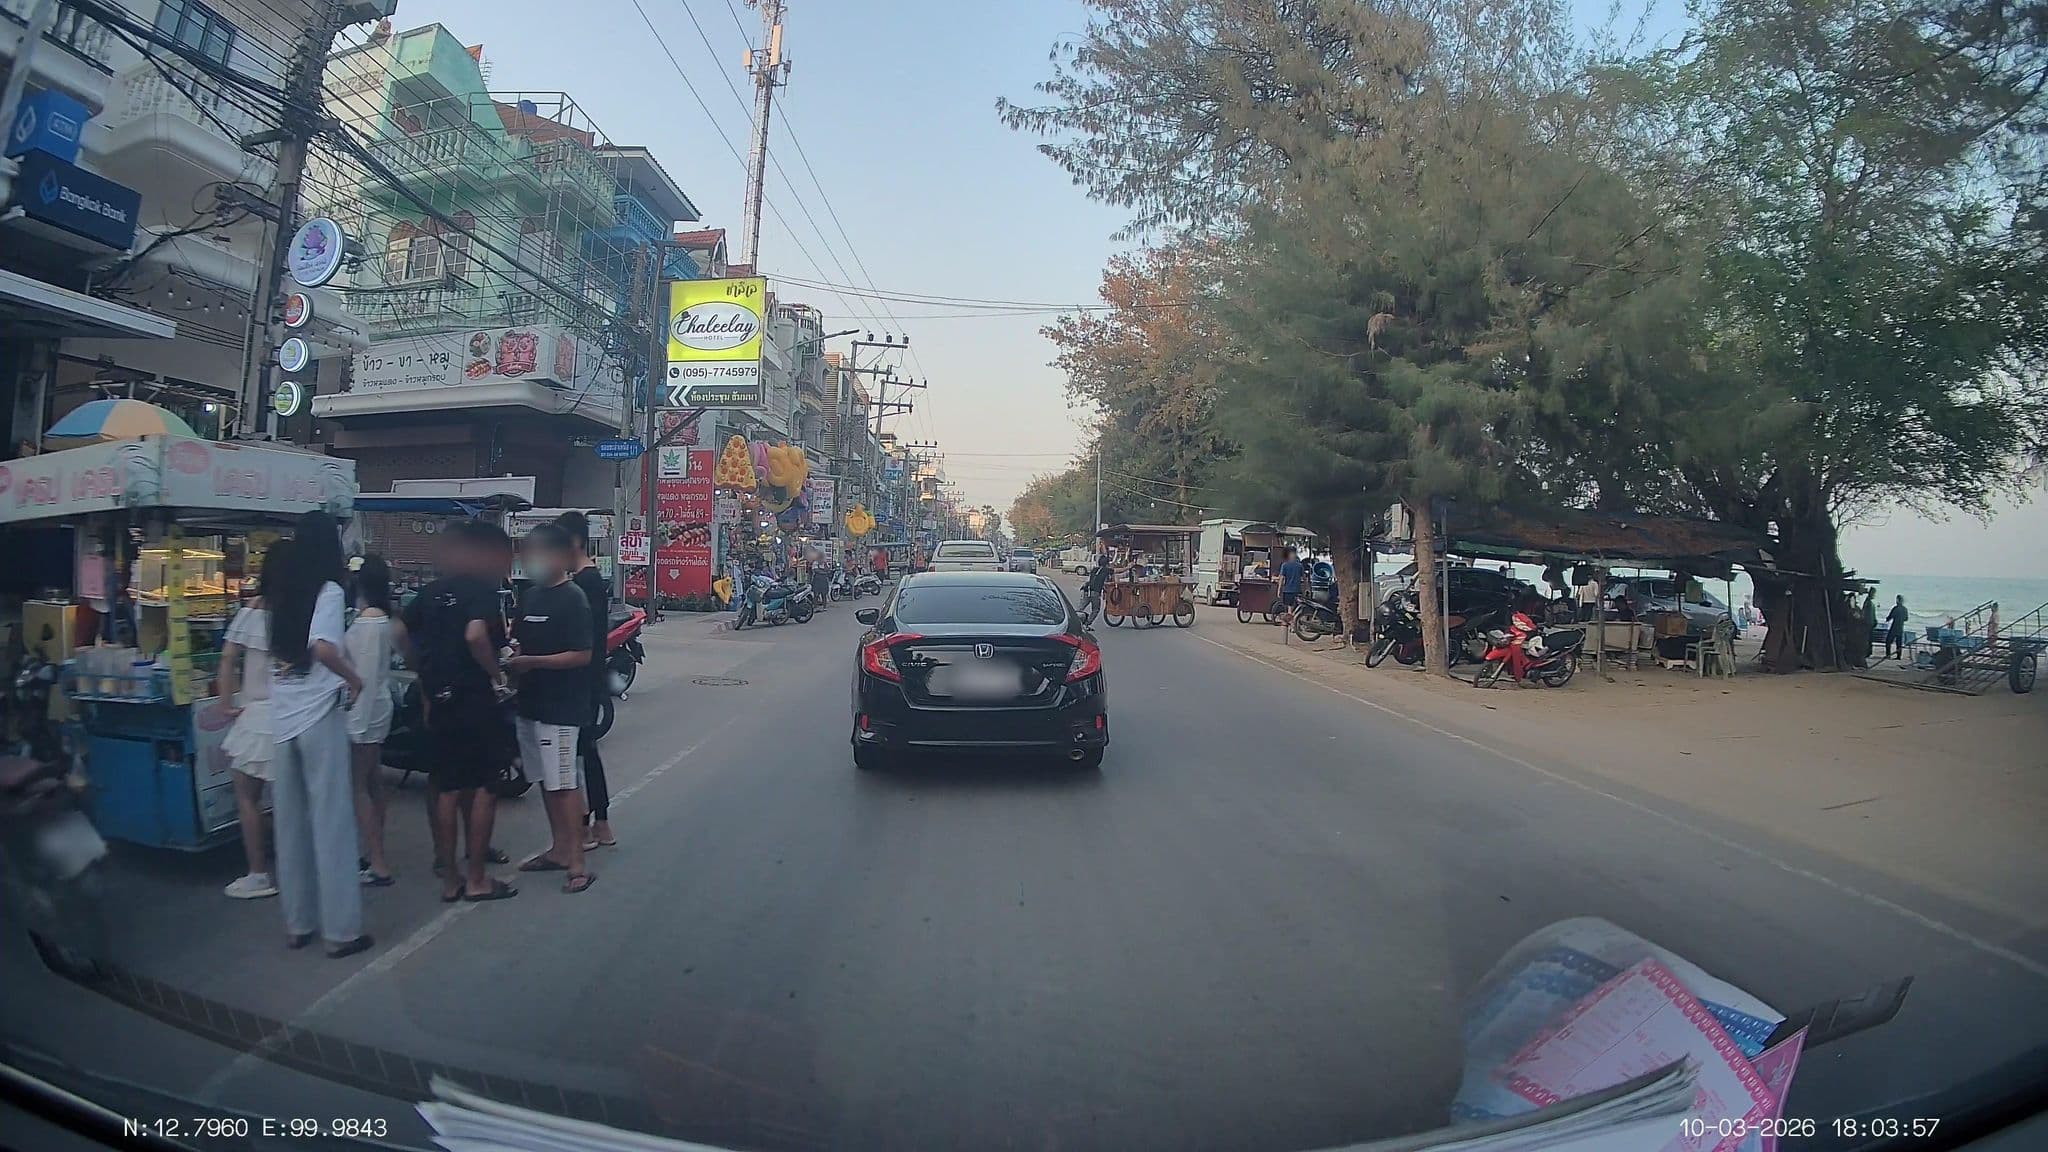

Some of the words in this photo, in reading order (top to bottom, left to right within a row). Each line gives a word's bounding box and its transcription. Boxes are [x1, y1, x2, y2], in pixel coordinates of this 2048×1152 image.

[59, 186, 102, 214] Bangkok
[101, 202, 127, 223] Bank
[675, 312, 756, 342] Chaleelay
[363, 354, 383, 371] ข้าว
[398, 356, 412, 367] ขา
[429, 352, 450, 371] หมู
[682, 367, 758, 379] (095)-7745979
[691, 390, 730, 404] ห้องประชุม
